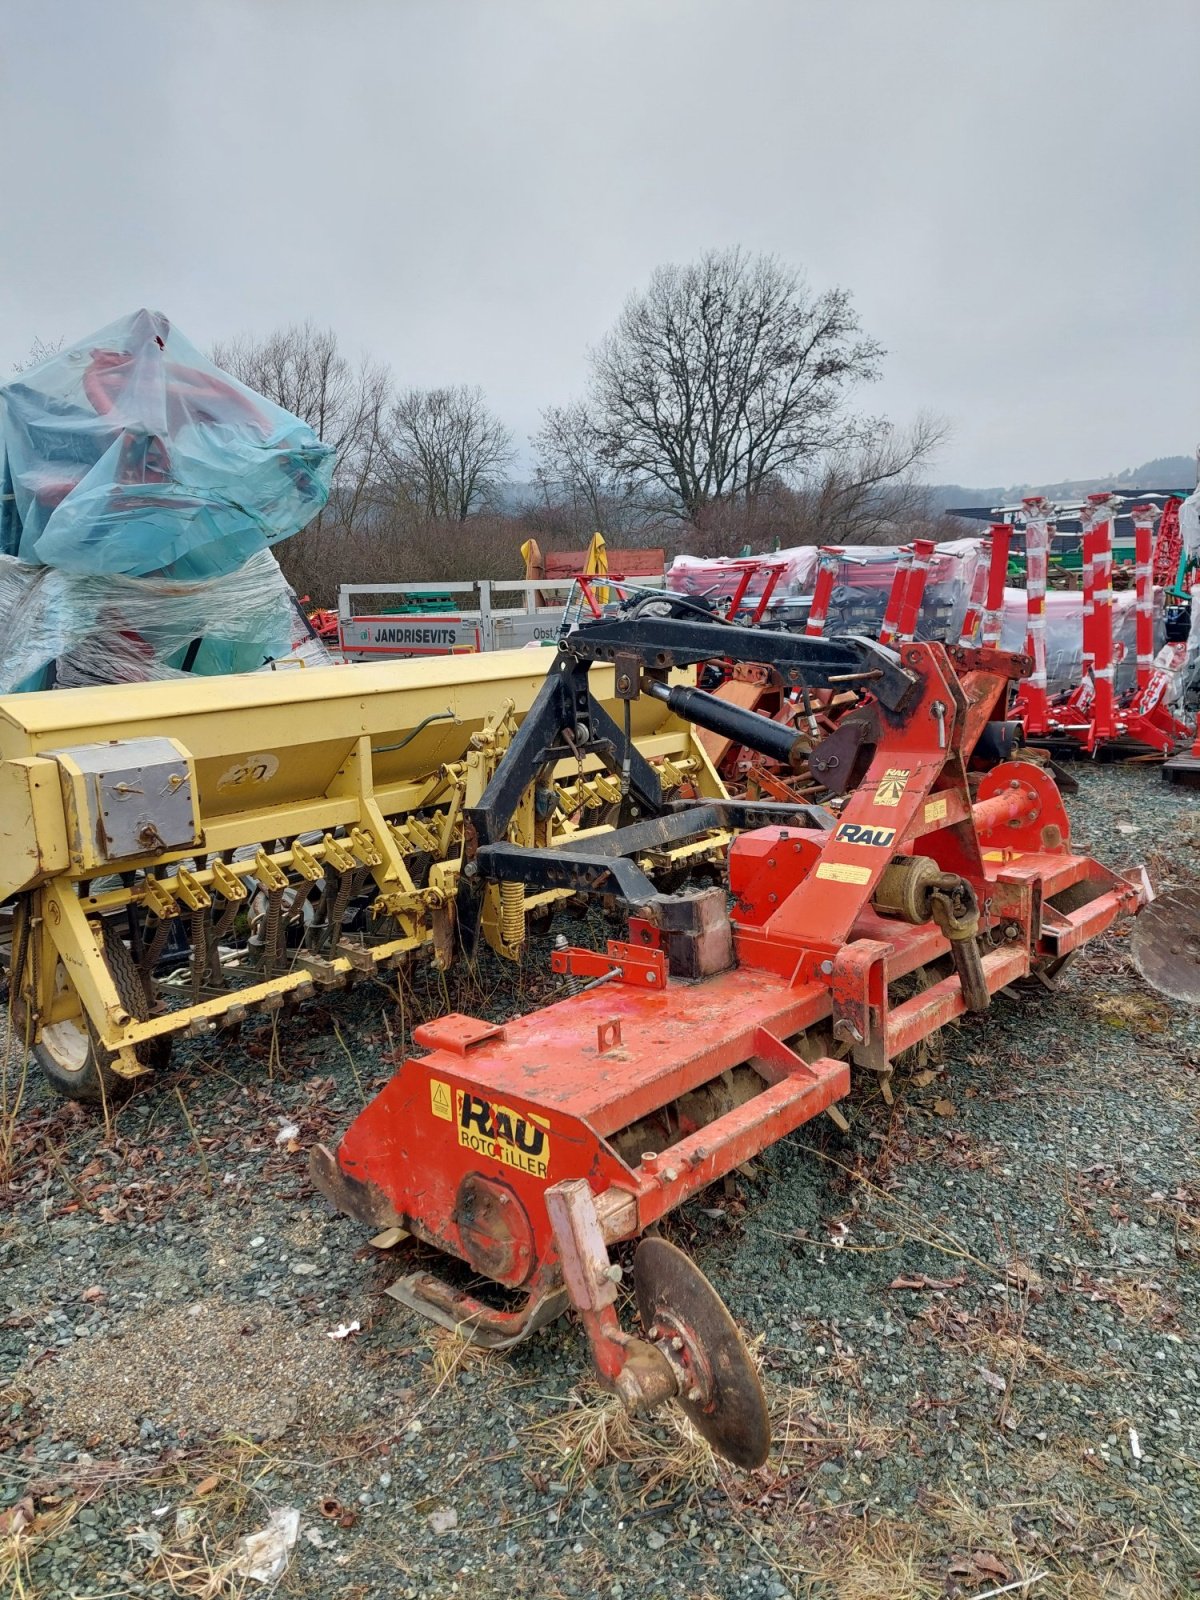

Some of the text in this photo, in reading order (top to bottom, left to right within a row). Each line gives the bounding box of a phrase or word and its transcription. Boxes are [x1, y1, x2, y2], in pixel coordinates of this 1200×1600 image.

[375, 629, 456, 644] JANDRISEVITS
[533, 627, 554, 640] Obst
[836, 825, 895, 846] RAU
[461, 1092, 545, 1156] RAU
